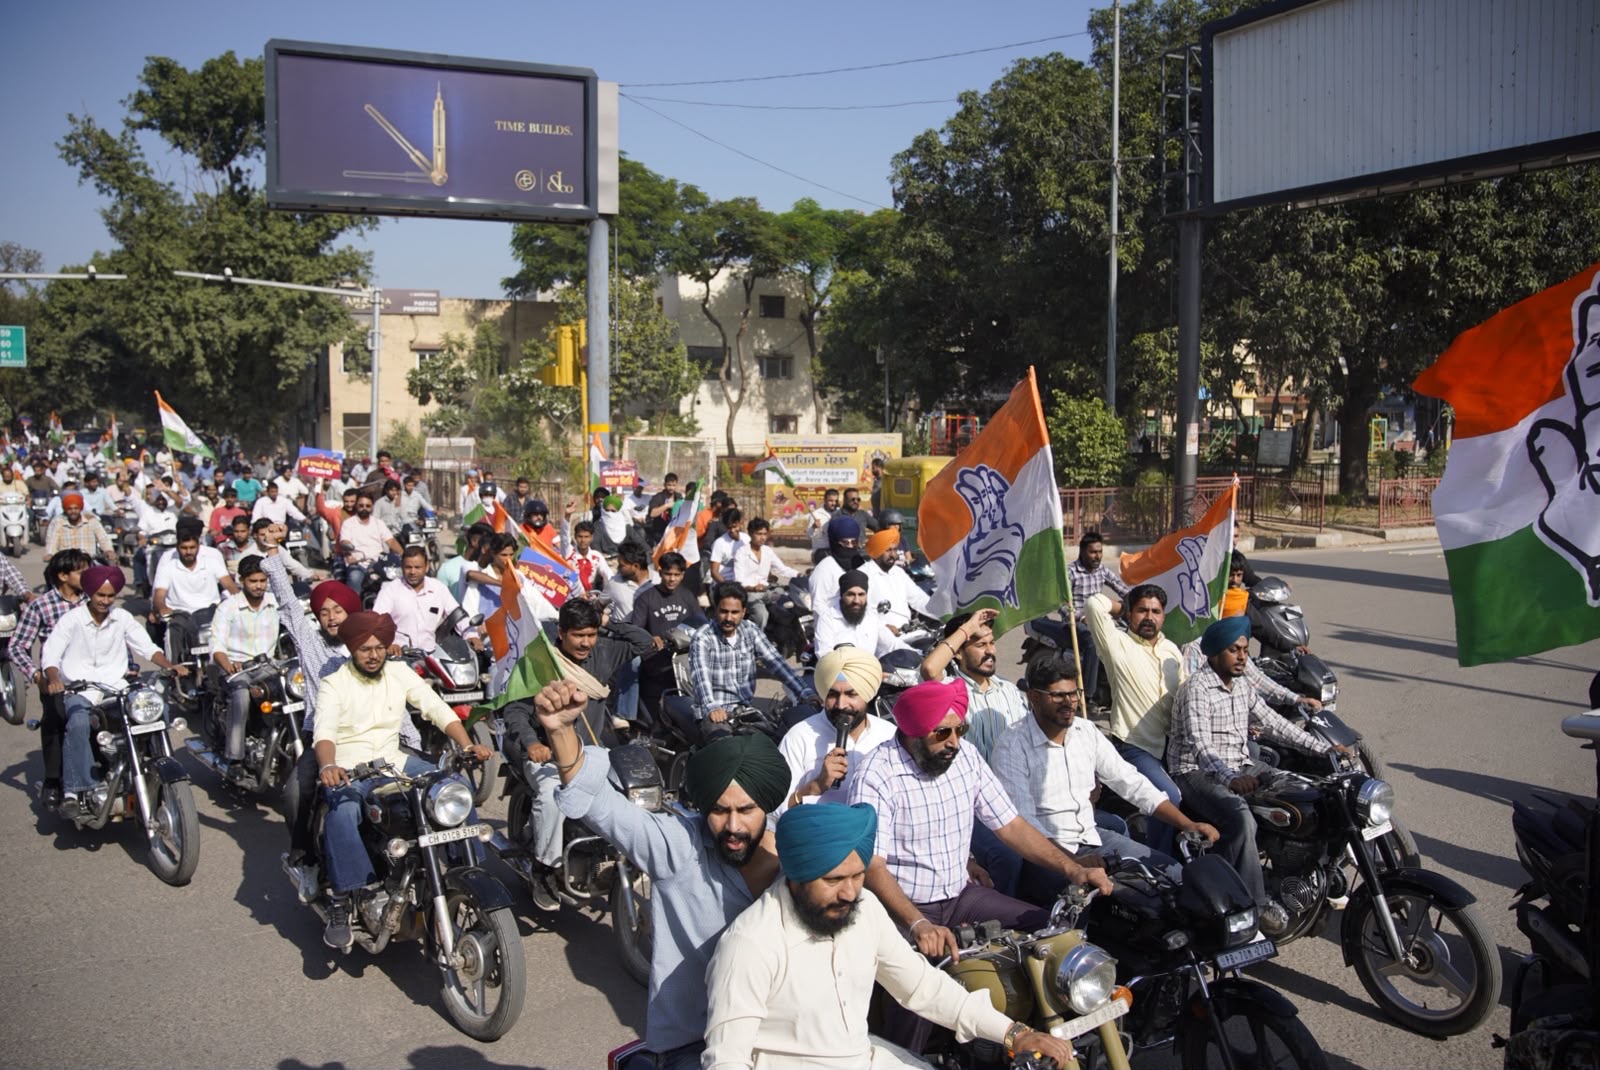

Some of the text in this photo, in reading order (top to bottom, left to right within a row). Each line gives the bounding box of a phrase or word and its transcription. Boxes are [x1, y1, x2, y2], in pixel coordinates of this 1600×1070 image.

[495, 120, 574, 136] TIME BUILDS.
[428, 835, 439, 844] CH
[463, 826, 478, 837] 5167
